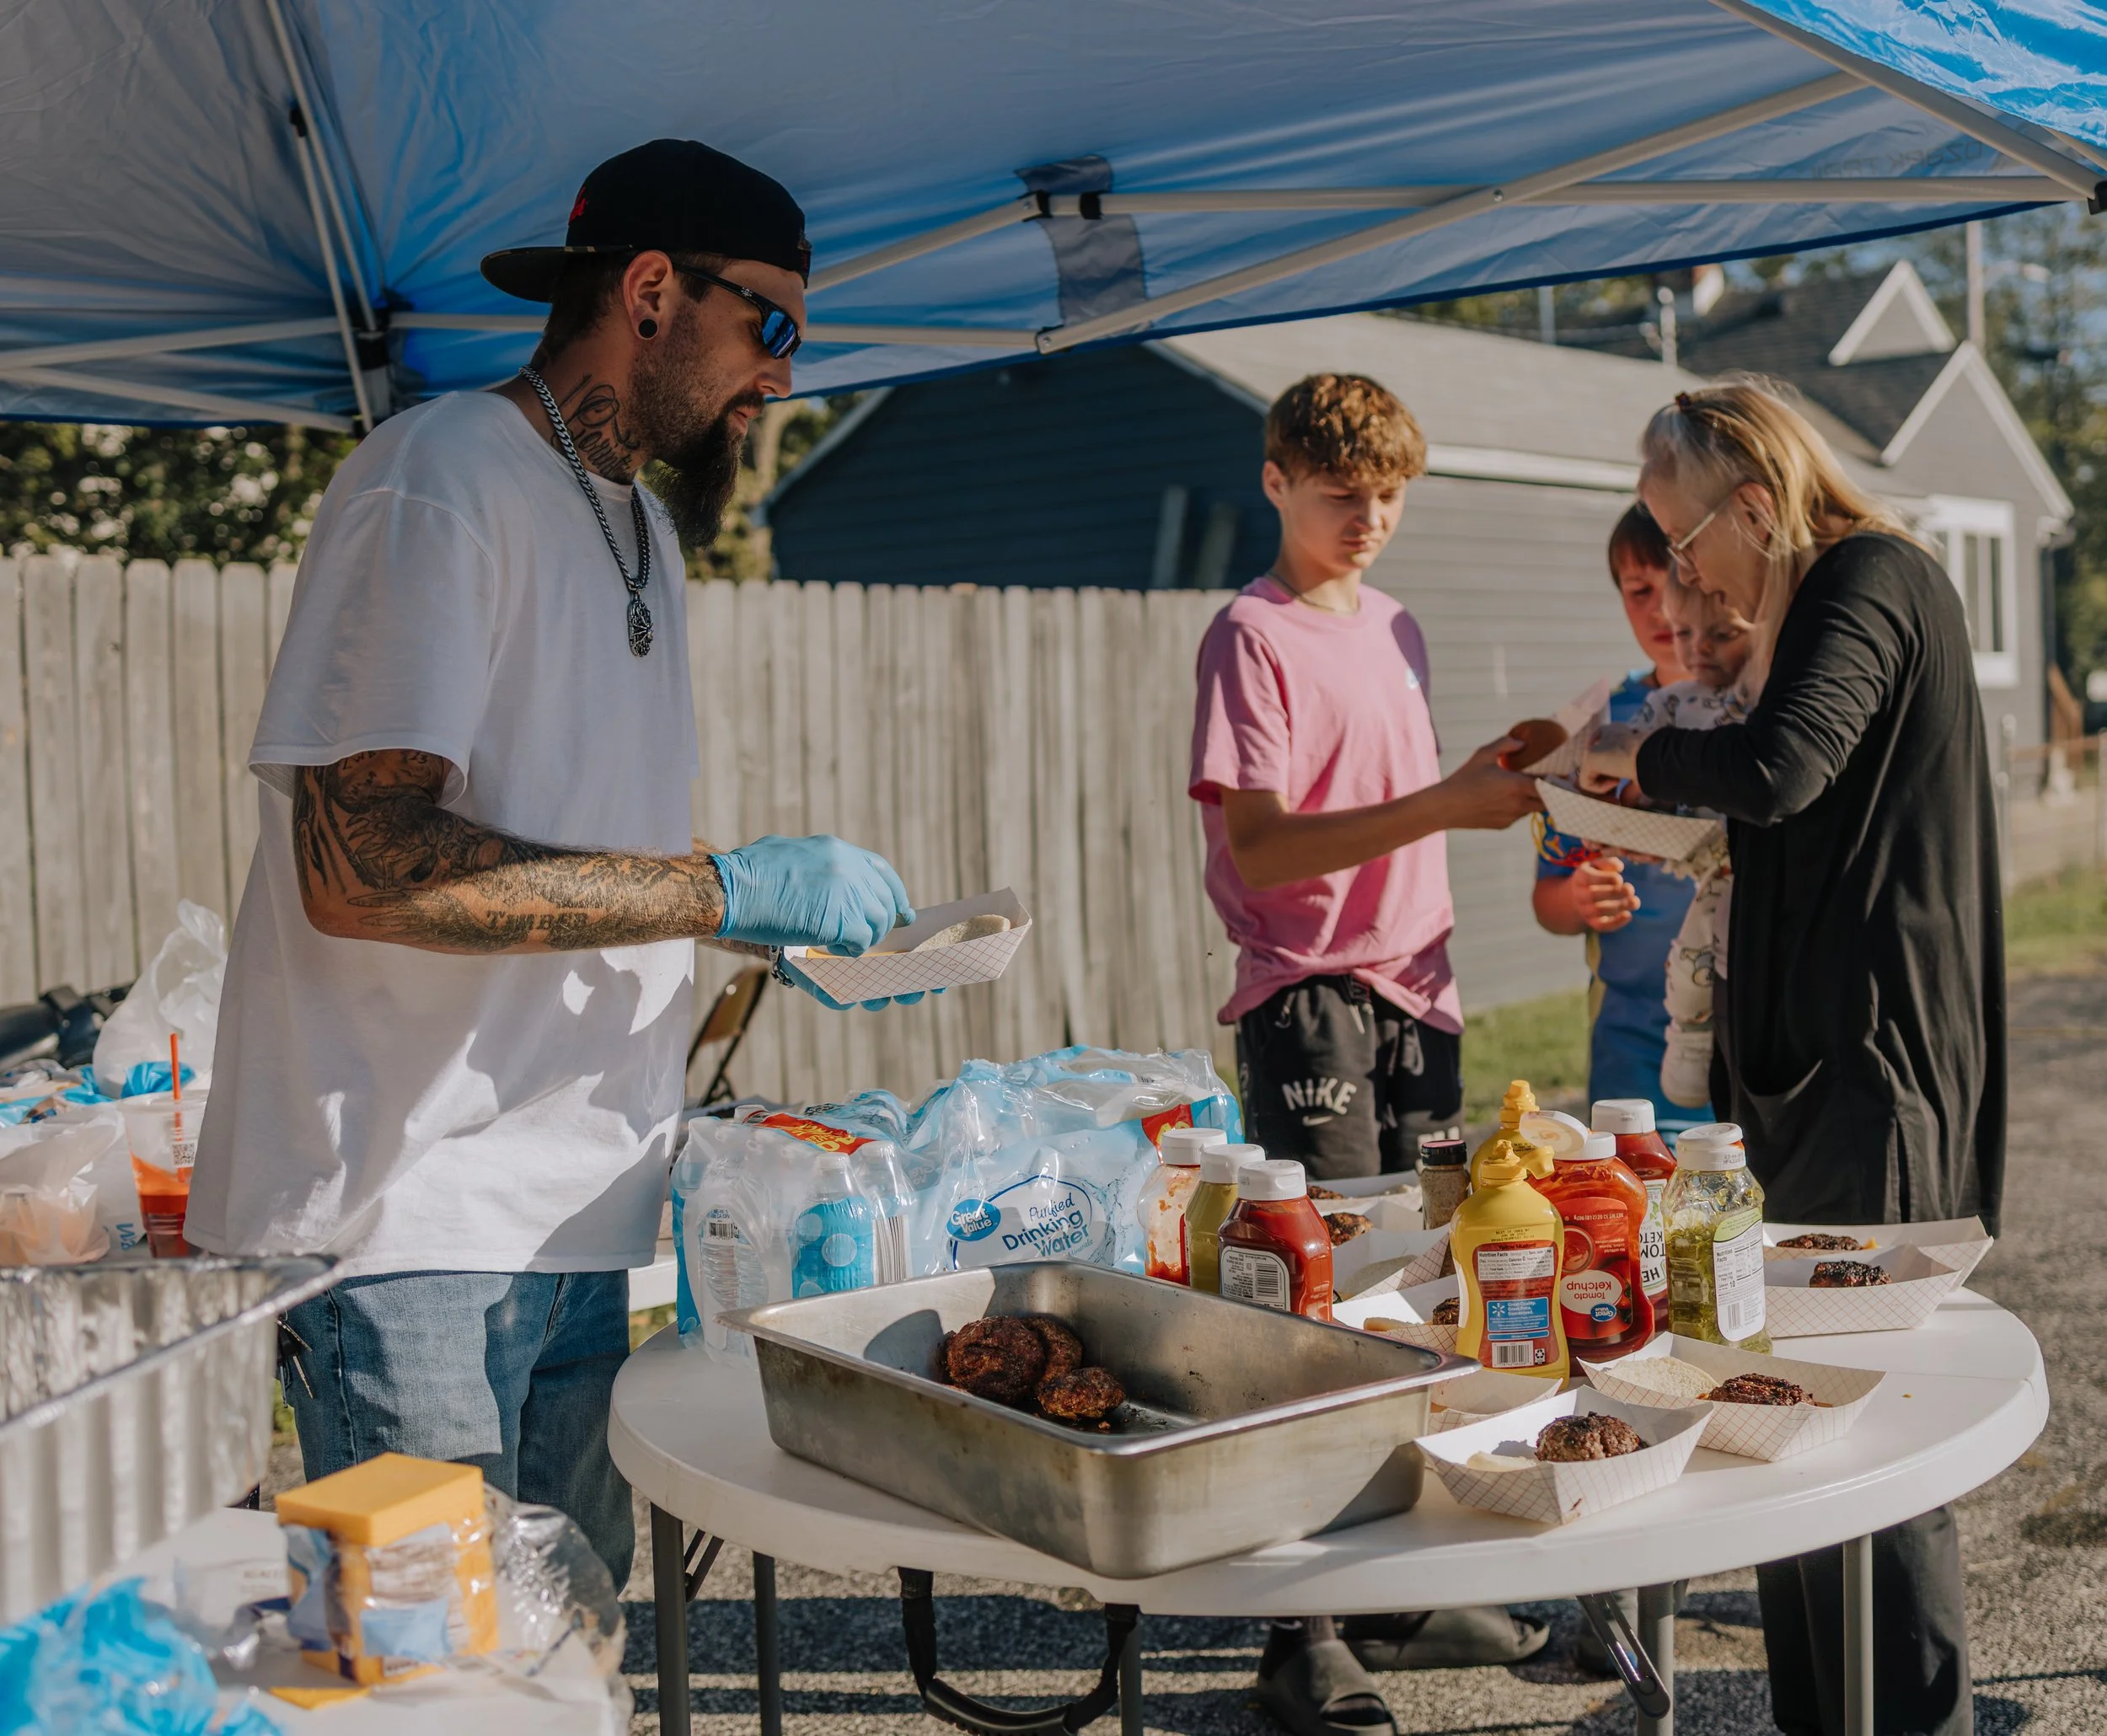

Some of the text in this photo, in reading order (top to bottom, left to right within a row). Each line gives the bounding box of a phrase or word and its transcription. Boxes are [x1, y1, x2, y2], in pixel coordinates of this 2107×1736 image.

[1282, 1077, 1357, 1115] NIKE
[1029, 1192, 1075, 1221] Purified
[950, 1207, 989, 1226] Great
[962, 1219, 993, 1235] Value
[1001, 1209, 1084, 1251] Drinking
[1033, 1224, 1090, 1256] Water
[1566, 1281, 1611, 1291] Ketchup
[1574, 1292, 1606, 1300] Tomato
[1595, 1310, 1614, 1318] Great
